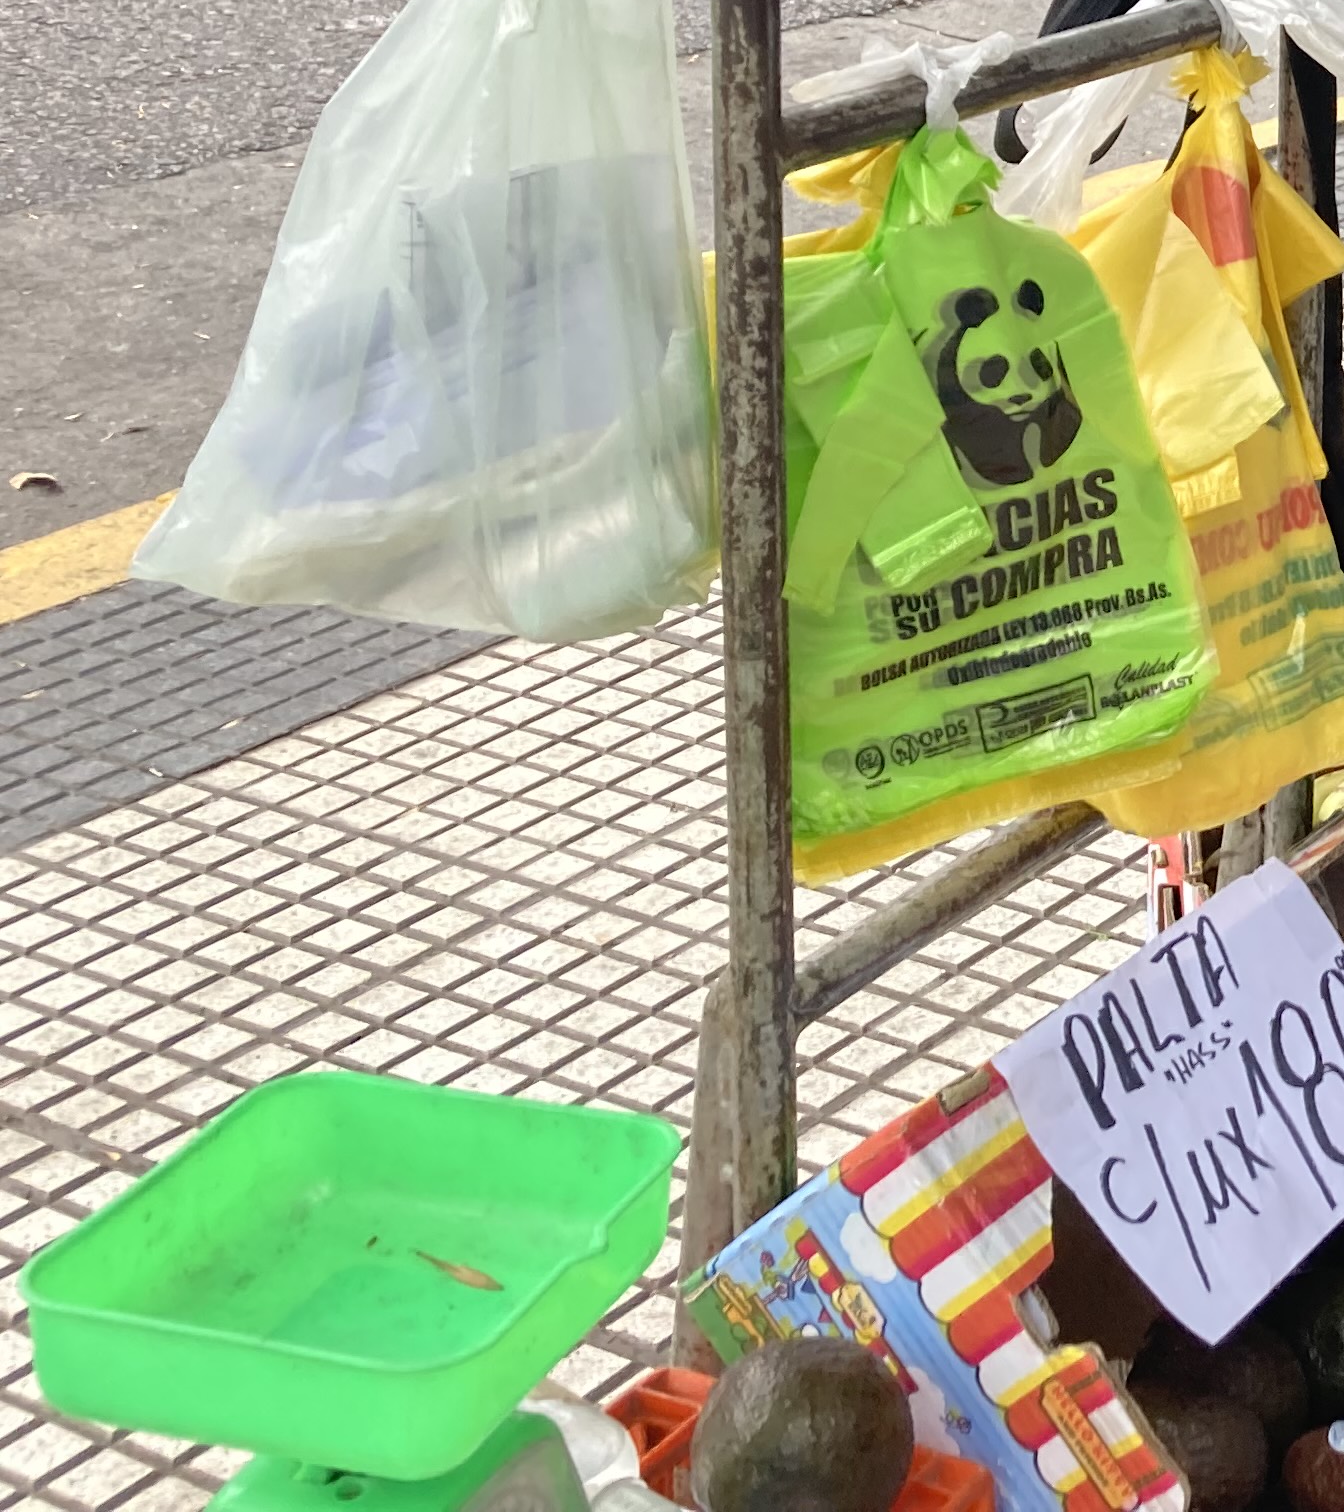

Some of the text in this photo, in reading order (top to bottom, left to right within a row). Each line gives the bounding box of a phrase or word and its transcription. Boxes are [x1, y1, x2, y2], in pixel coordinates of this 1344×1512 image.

[984, 467, 1119, 558] CIAS
[891, 589, 940, 619] POR
[895, 525, 1125, 640] SU COMPRA
[861, 657, 908, 692] BOLSA
[910, 627, 1002, 676] AUTORIZADA
[1003, 618, 1029, 640] LEY
[1085, 594, 1124, 622] Prov.
[1125, 581, 1173, 608] Bs.As.
[1113, 652, 1180, 689] Calidad
[918, 719, 968, 747] OPDS
[1060, 914, 1240, 1131] PALTA
